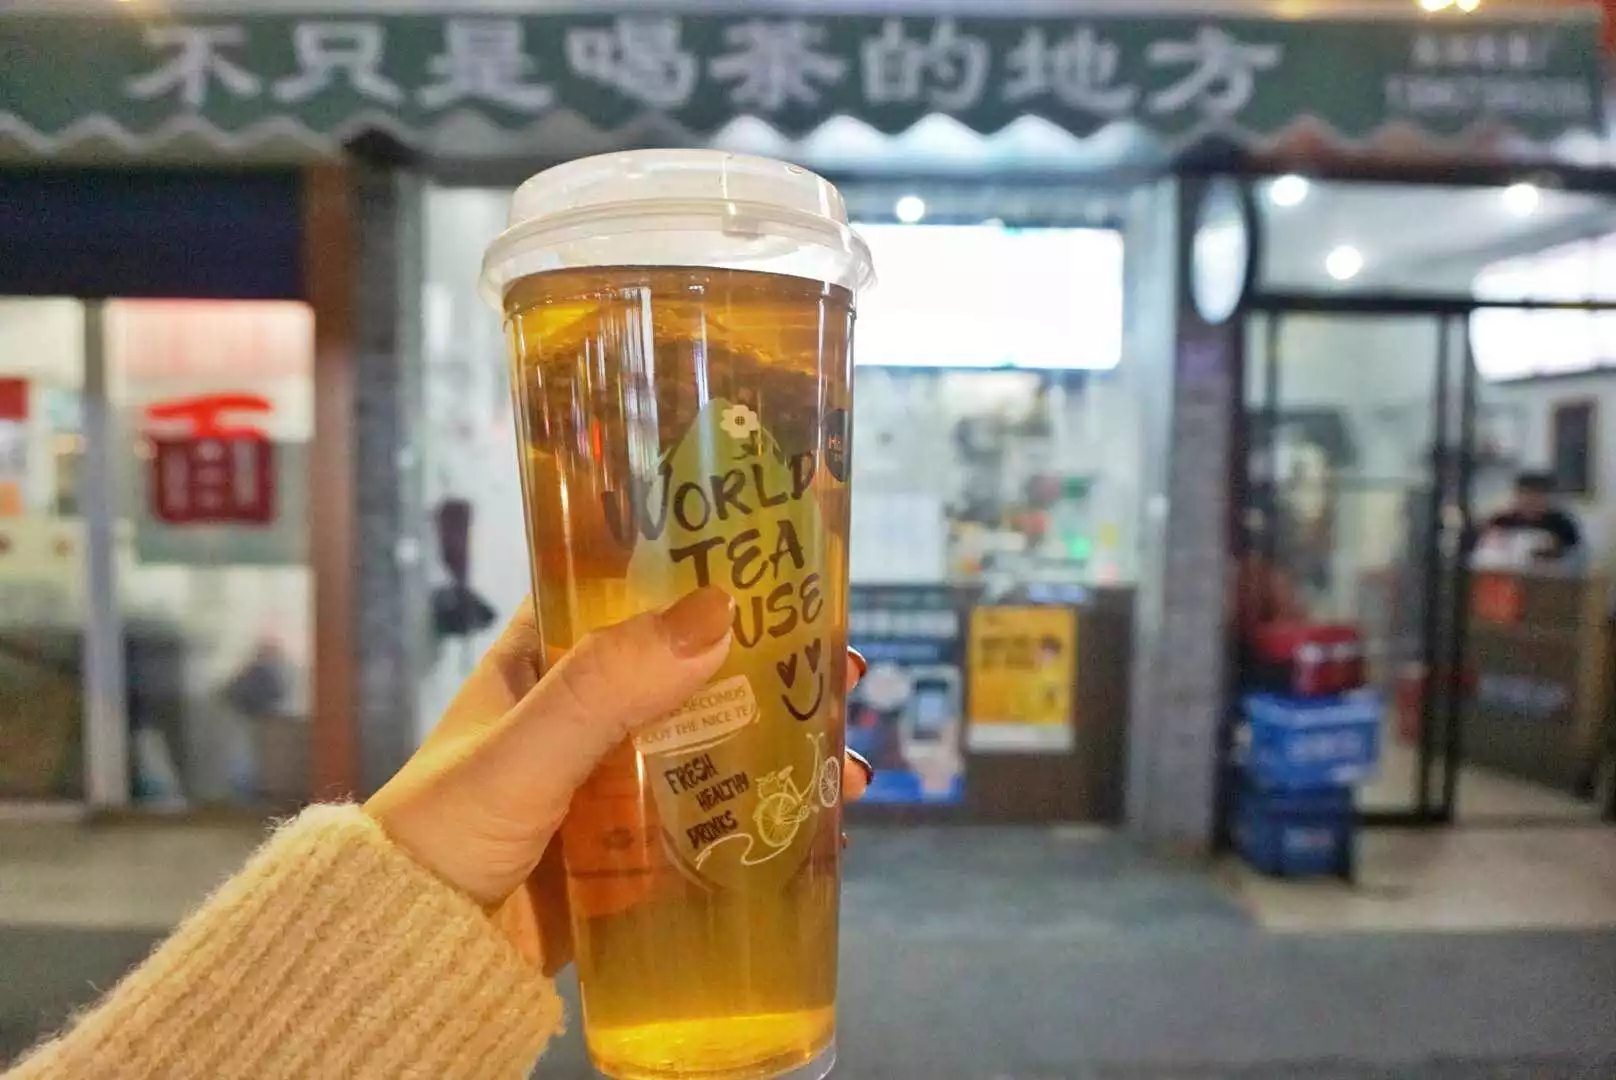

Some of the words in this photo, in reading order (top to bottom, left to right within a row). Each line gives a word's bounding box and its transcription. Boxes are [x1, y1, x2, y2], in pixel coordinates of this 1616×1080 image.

[126, 17, 1282, 114] 不只是喝茶的地方
[601, 451, 816, 548] WORLD
[669, 519, 805, 590] TEA
[733, 573, 823, 648] USE
[701, 711, 733, 727] NICE
[664, 752, 719, 795] FRESH
[686, 809, 739, 849] DRINKS
